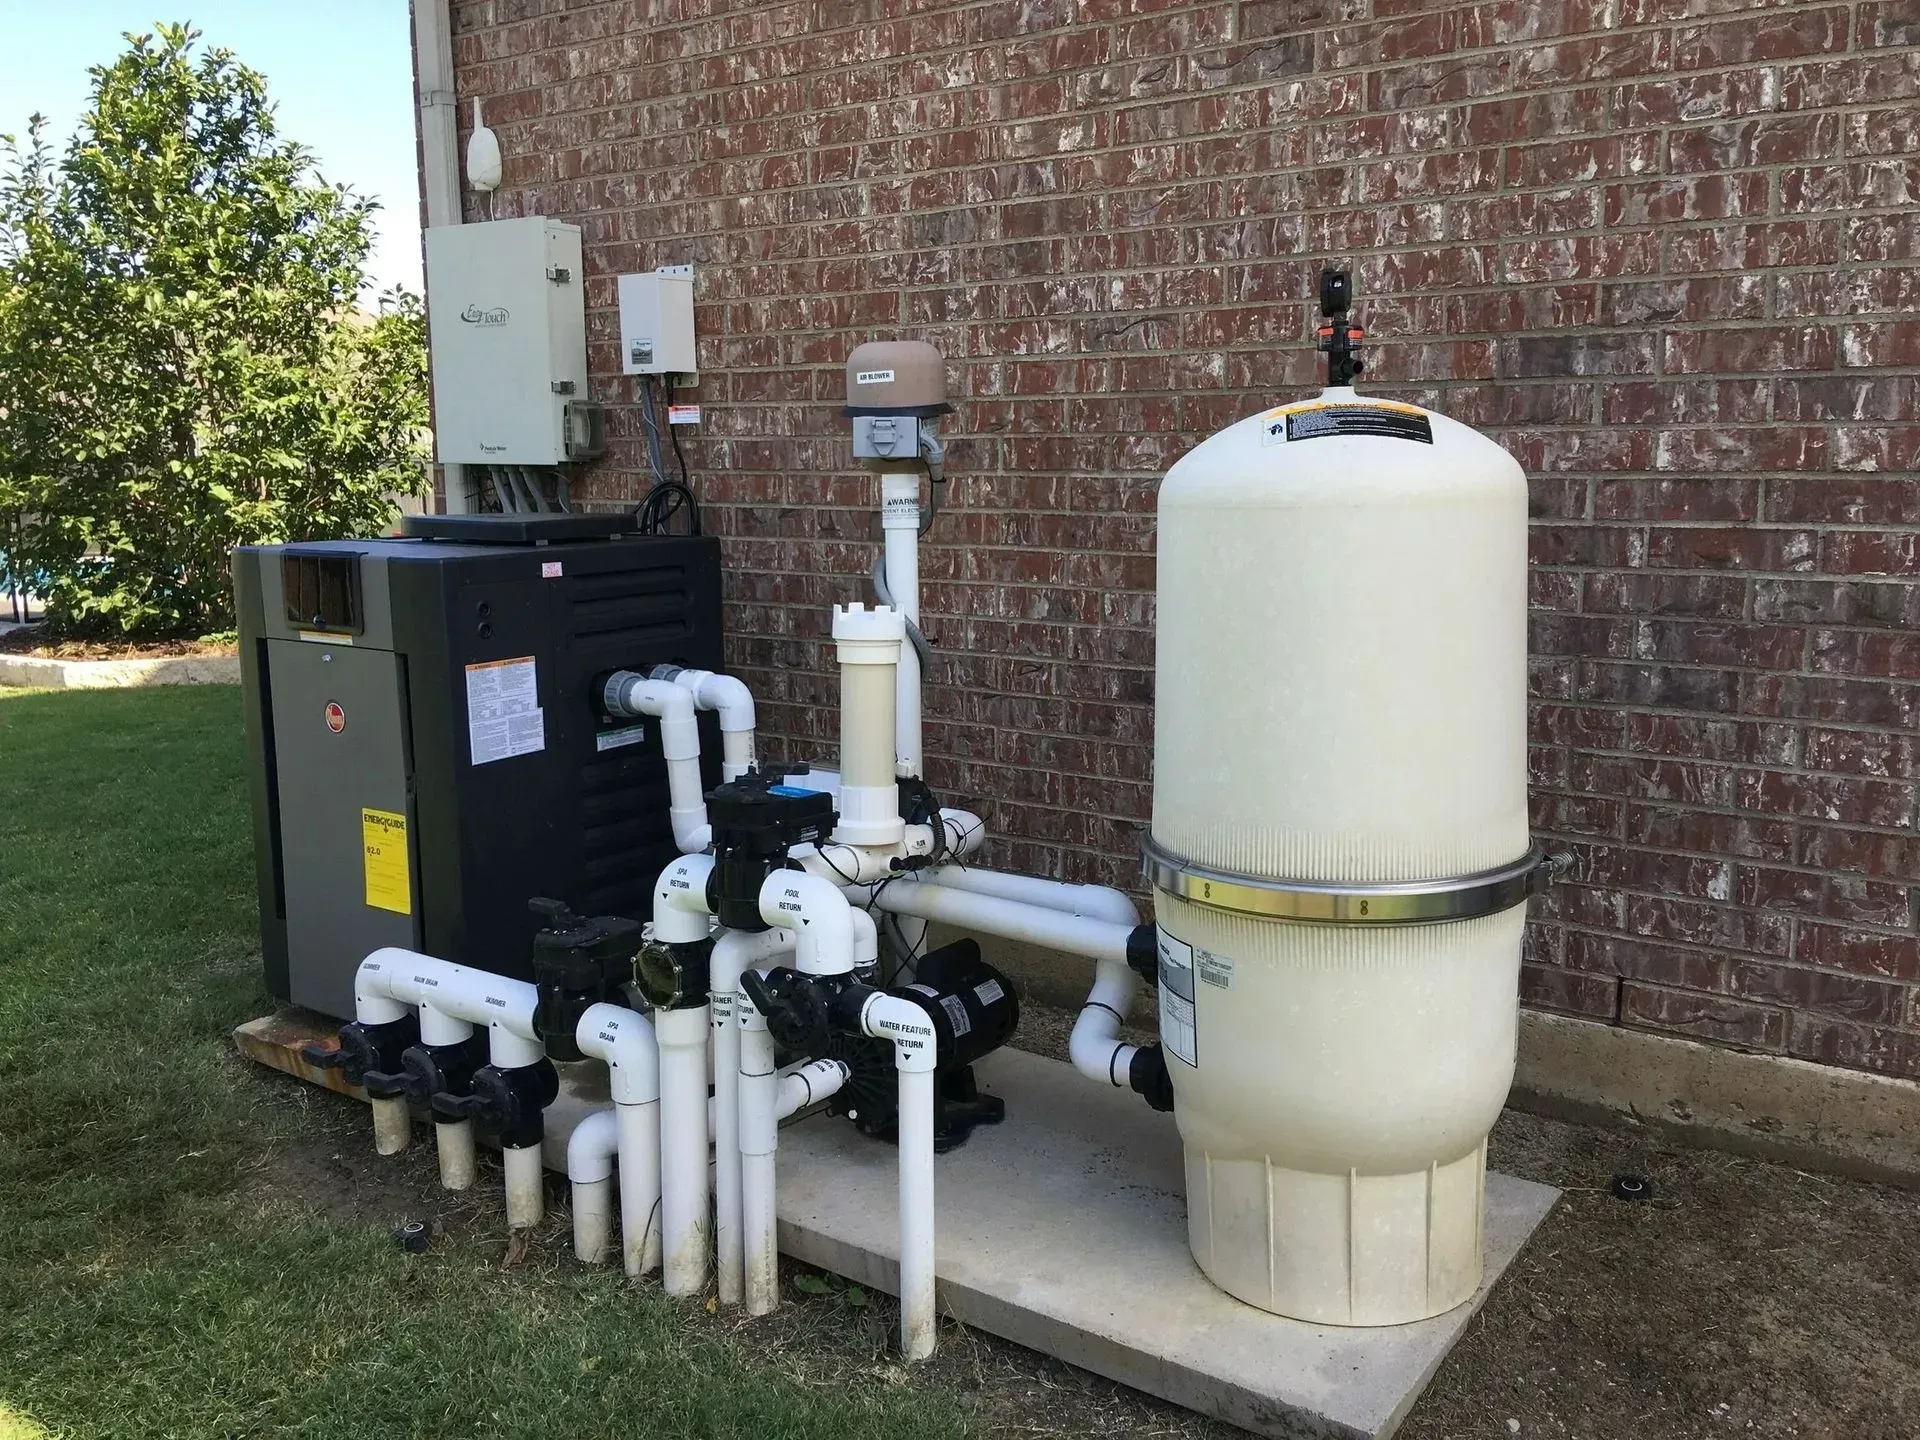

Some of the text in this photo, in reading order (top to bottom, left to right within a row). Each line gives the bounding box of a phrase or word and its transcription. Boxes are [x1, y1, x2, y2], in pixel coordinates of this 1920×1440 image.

[677, 867, 688, 876] SPA
[670, 879, 690, 889] RETURN
[784, 888, 800, 899] POOL
[779, 901, 802, 912] RETURN
[425, 978, 439, 987] DRAIN
[485, 995, 507, 1008] SKIMMER
[713, 996, 733, 1004] EANER
[713, 1008, 731, 1017] ETURN
[738, 1005, 754, 1015] ETURN
[607, 1021, 619, 1031] SPA
[879, 1020, 932, 1037] WATER FEATURE
[599, 1031, 616, 1043] DRAIN
[896, 1038, 924, 1049] RETURN
